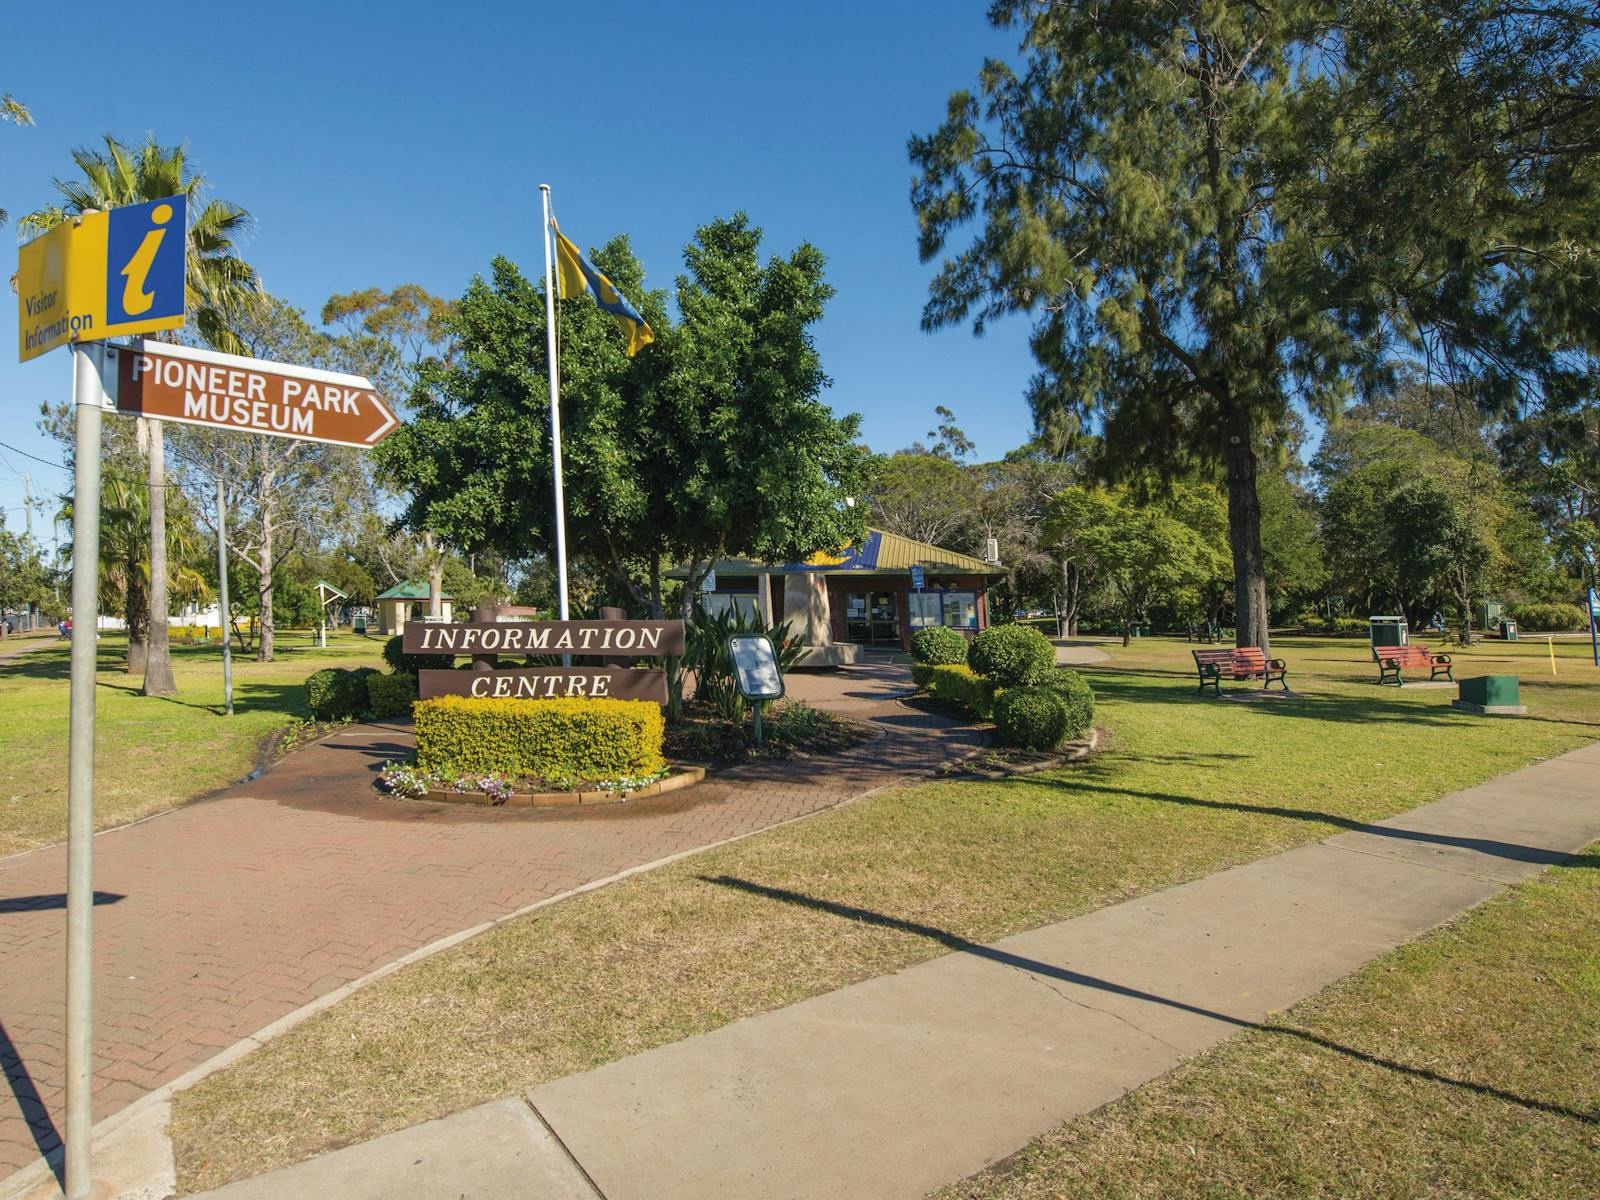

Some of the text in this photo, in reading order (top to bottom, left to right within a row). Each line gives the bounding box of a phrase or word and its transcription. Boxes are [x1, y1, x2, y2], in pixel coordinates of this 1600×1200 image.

[25, 290, 58, 318] Visitor
[25, 310, 93, 351] Information
[131, 355, 361, 416] PIONEER PARK
[183, 390, 315, 435] MUSEUM
[420, 627, 664, 650] INFORMATION
[471, 674, 613, 698] CENTRE
